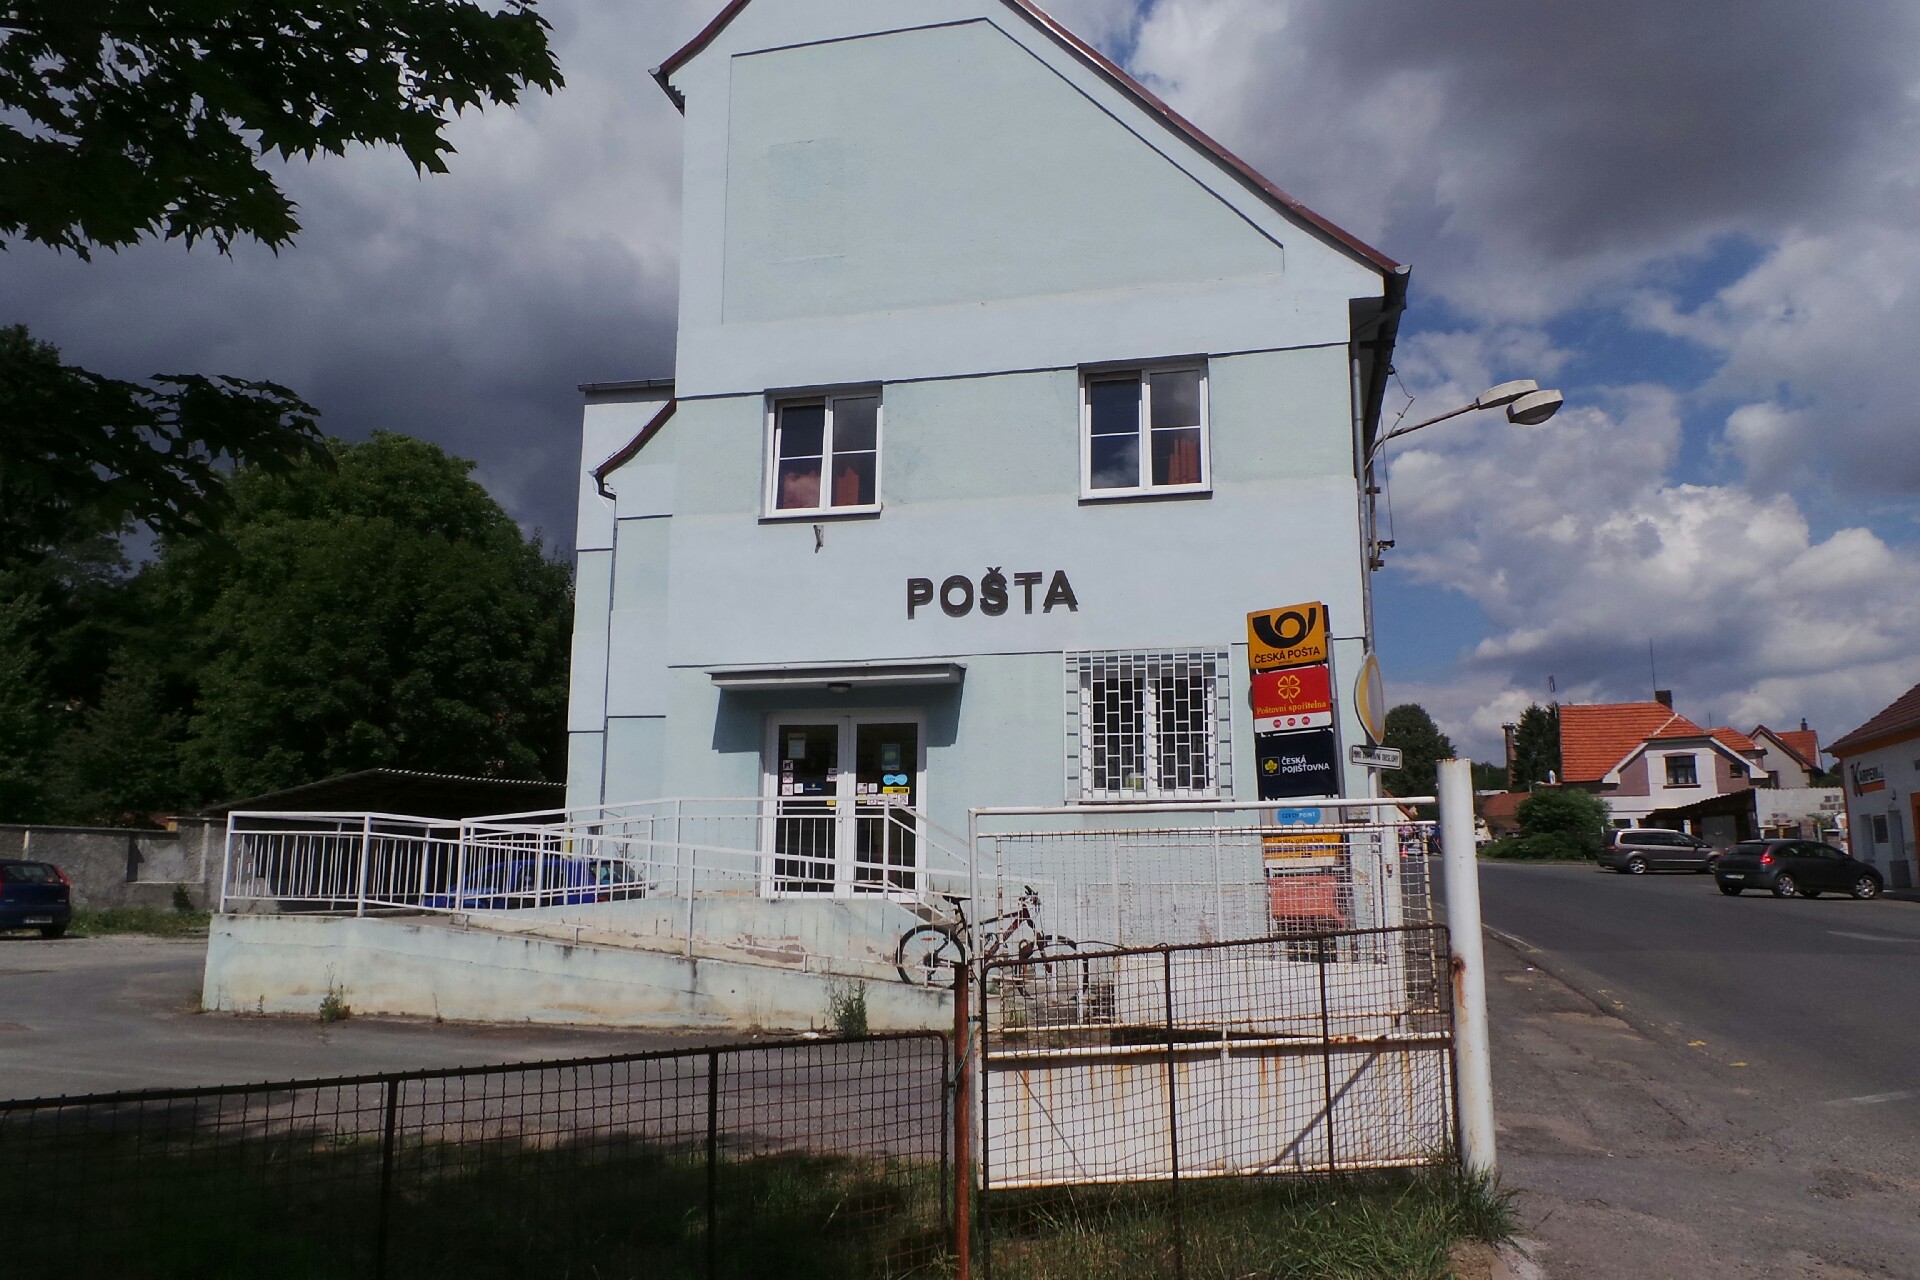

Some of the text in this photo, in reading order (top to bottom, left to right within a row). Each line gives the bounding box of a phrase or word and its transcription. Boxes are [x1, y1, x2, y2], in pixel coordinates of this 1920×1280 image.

[907, 566, 1079, 620] POŠTA
[1254, 646, 1321, 664] ČESKÁ POŠTA
[1256, 700, 1327, 715] Poštovní spořitelna
[1281, 755, 1307, 765] ČESKÁ
[1282, 762, 1331, 774] POJIŠŤOVNA
